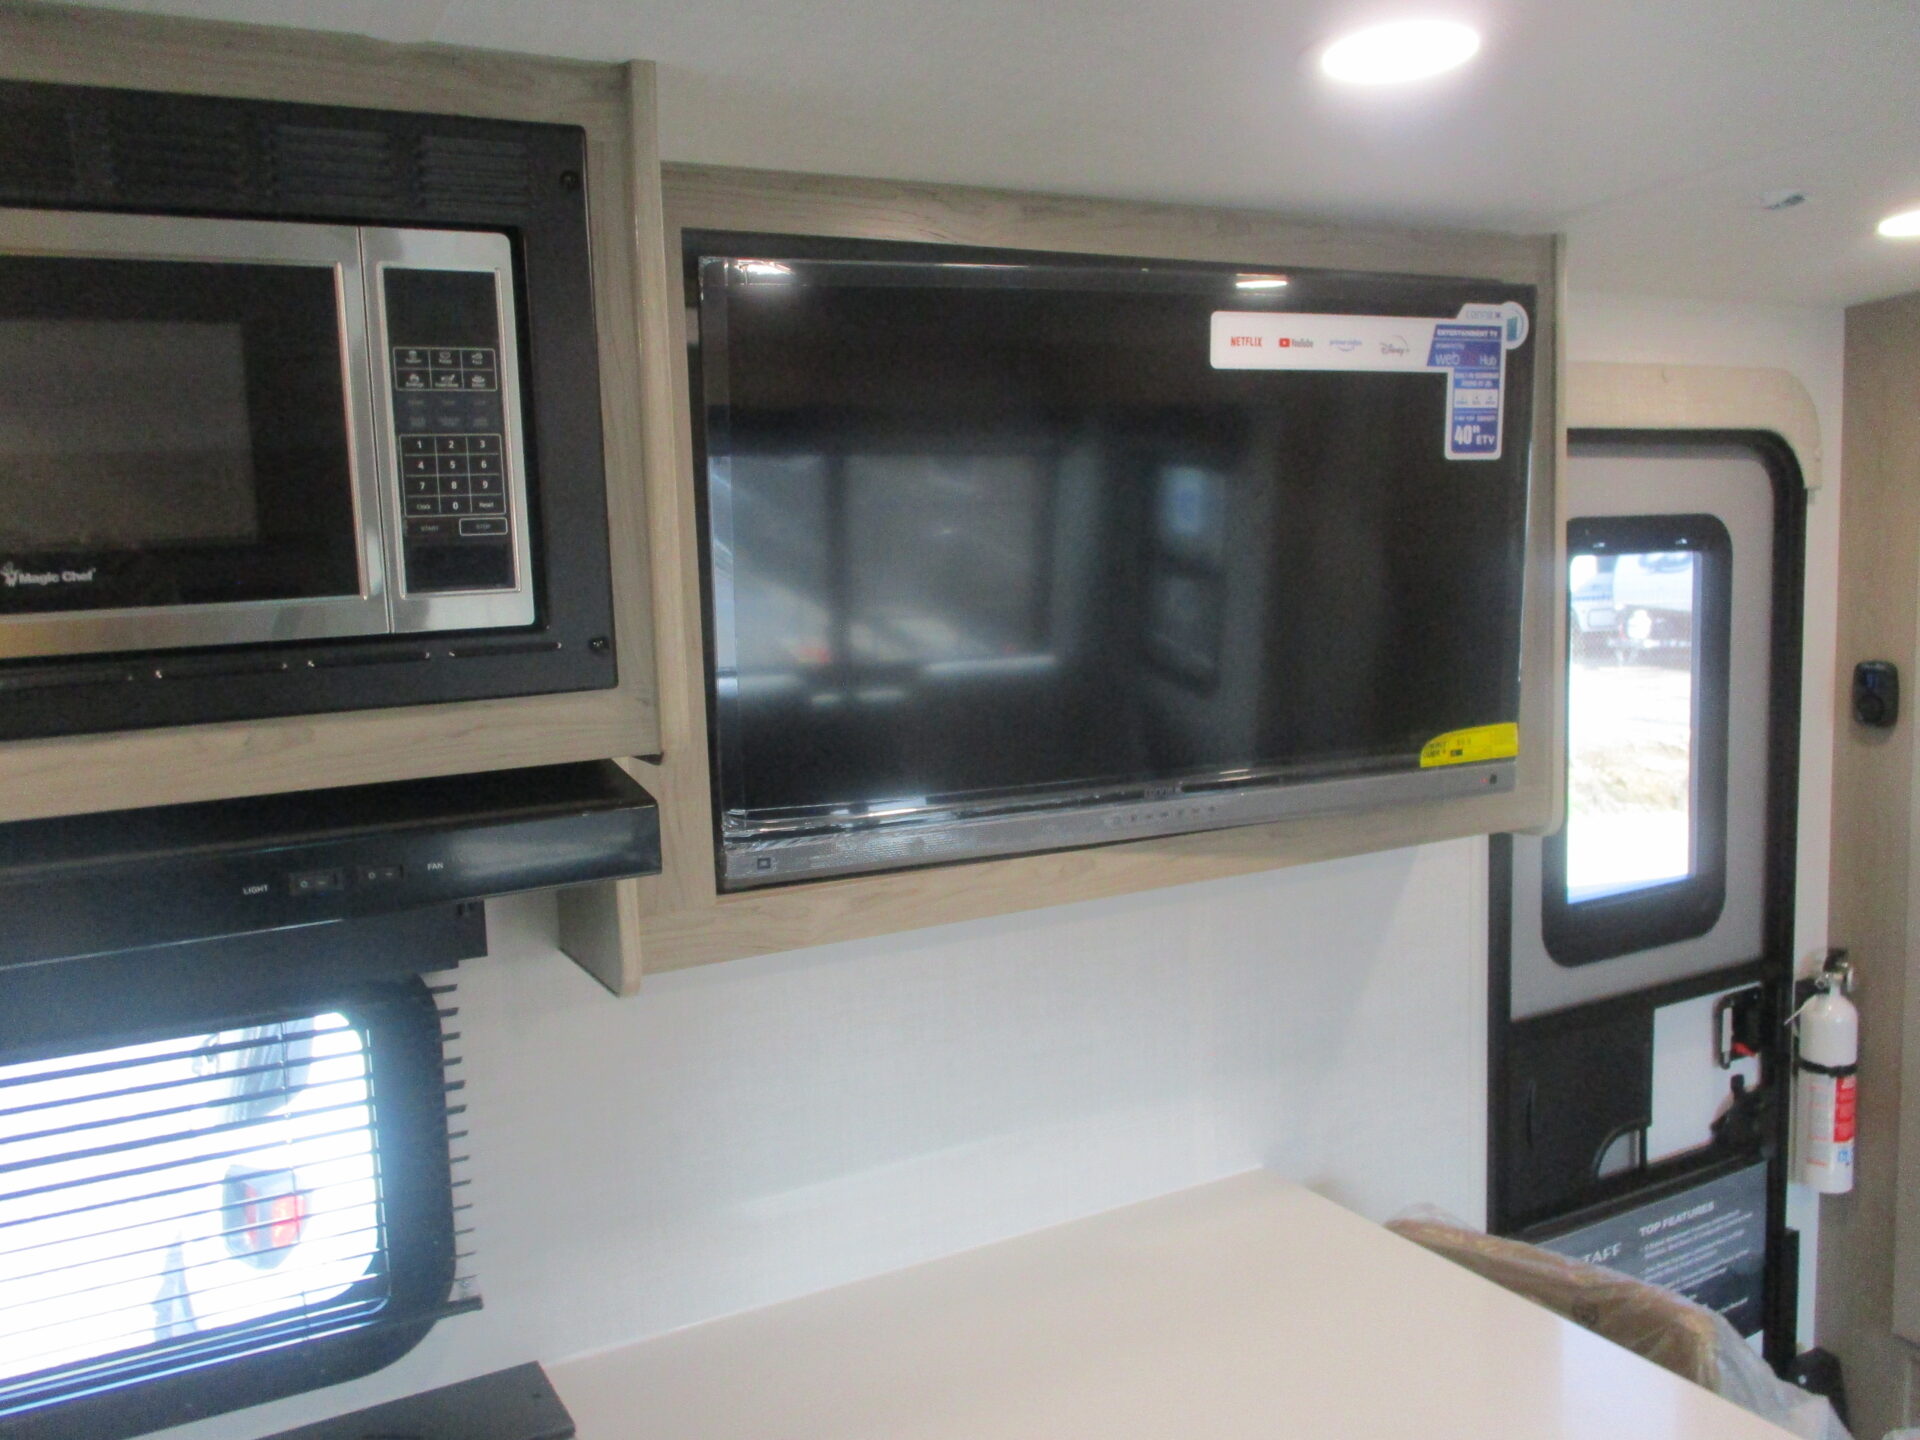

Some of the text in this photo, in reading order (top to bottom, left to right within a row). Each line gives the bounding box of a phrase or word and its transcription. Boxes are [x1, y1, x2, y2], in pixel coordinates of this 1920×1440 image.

[1230, 336, 1263, 347] NETFLIX
[1291, 338, 1314, 349] YouTube
[1479, 355, 1497, 366] Hub
[416, 440, 422, 449] 1
[448, 440, 454, 449] 2
[479, 440, 486, 449] 3
[417, 460, 424, 470] 4
[449, 460, 456, 469] 5
[481, 460, 487, 469] 6
[419, 482, 425, 490] 7
[451, 481, 457, 490] 8
[482, 480, 489, 489] 9
[452, 501, 459, 511] 0
[19, 570, 93, 586] Magic Chef
[427, 861, 444, 871] FAN
[242, 884, 268, 896] LIGHT
[1639, 1219, 1663, 1237] TOP
[1662, 1201, 1715, 1227] FEATURES
